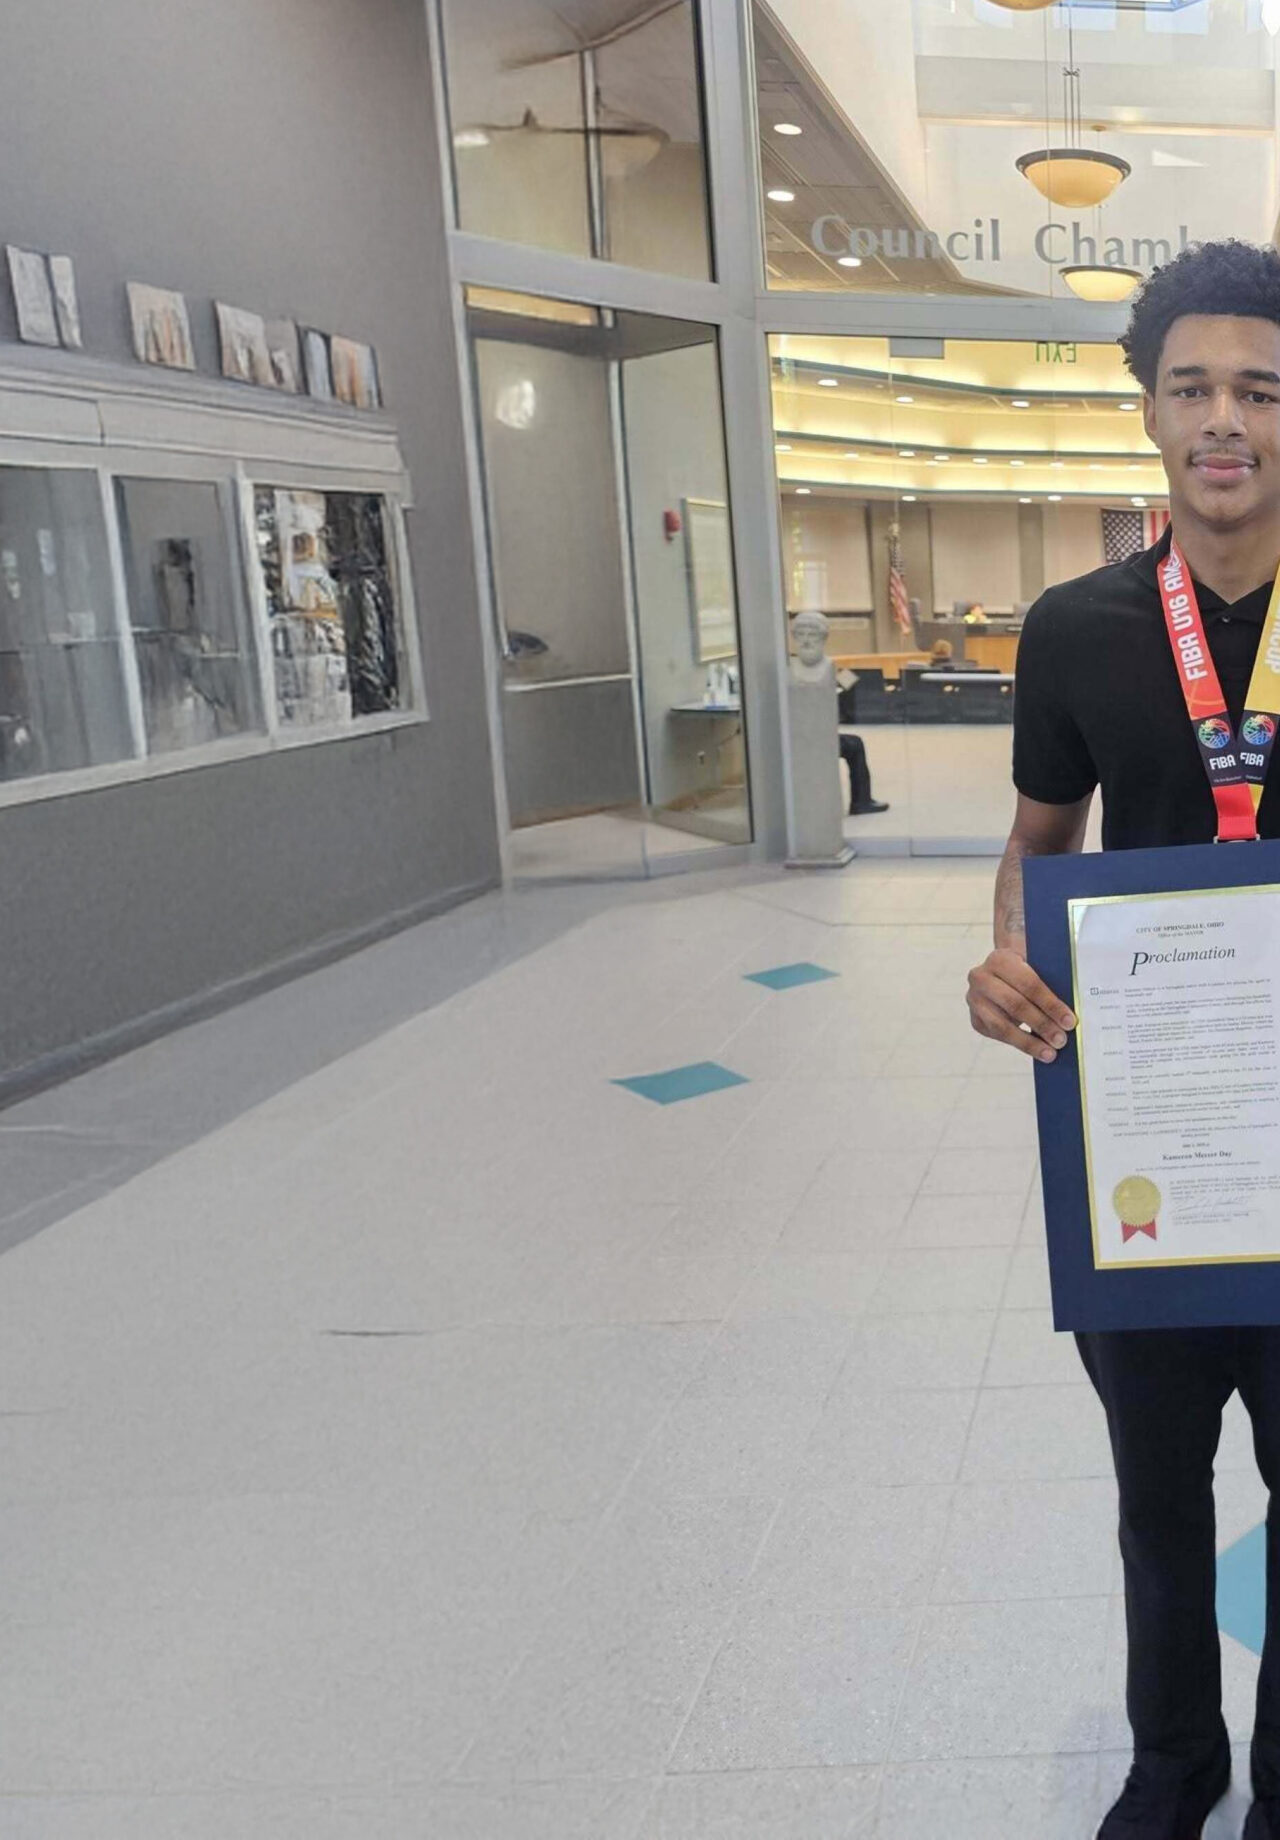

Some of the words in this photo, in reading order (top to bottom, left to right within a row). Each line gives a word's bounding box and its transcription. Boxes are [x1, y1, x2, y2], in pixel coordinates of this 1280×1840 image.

[811, 214, 1001, 262] Council
[1162, 551, 1186, 593] AM
[1168, 594, 1194, 632] U16
[1178, 632, 1208, 681] FIBA
[1209, 754, 1237, 770] FIBA
[1240, 752, 1265, 767] FIBA
[1128, 946, 1236, 976] Proclamation
